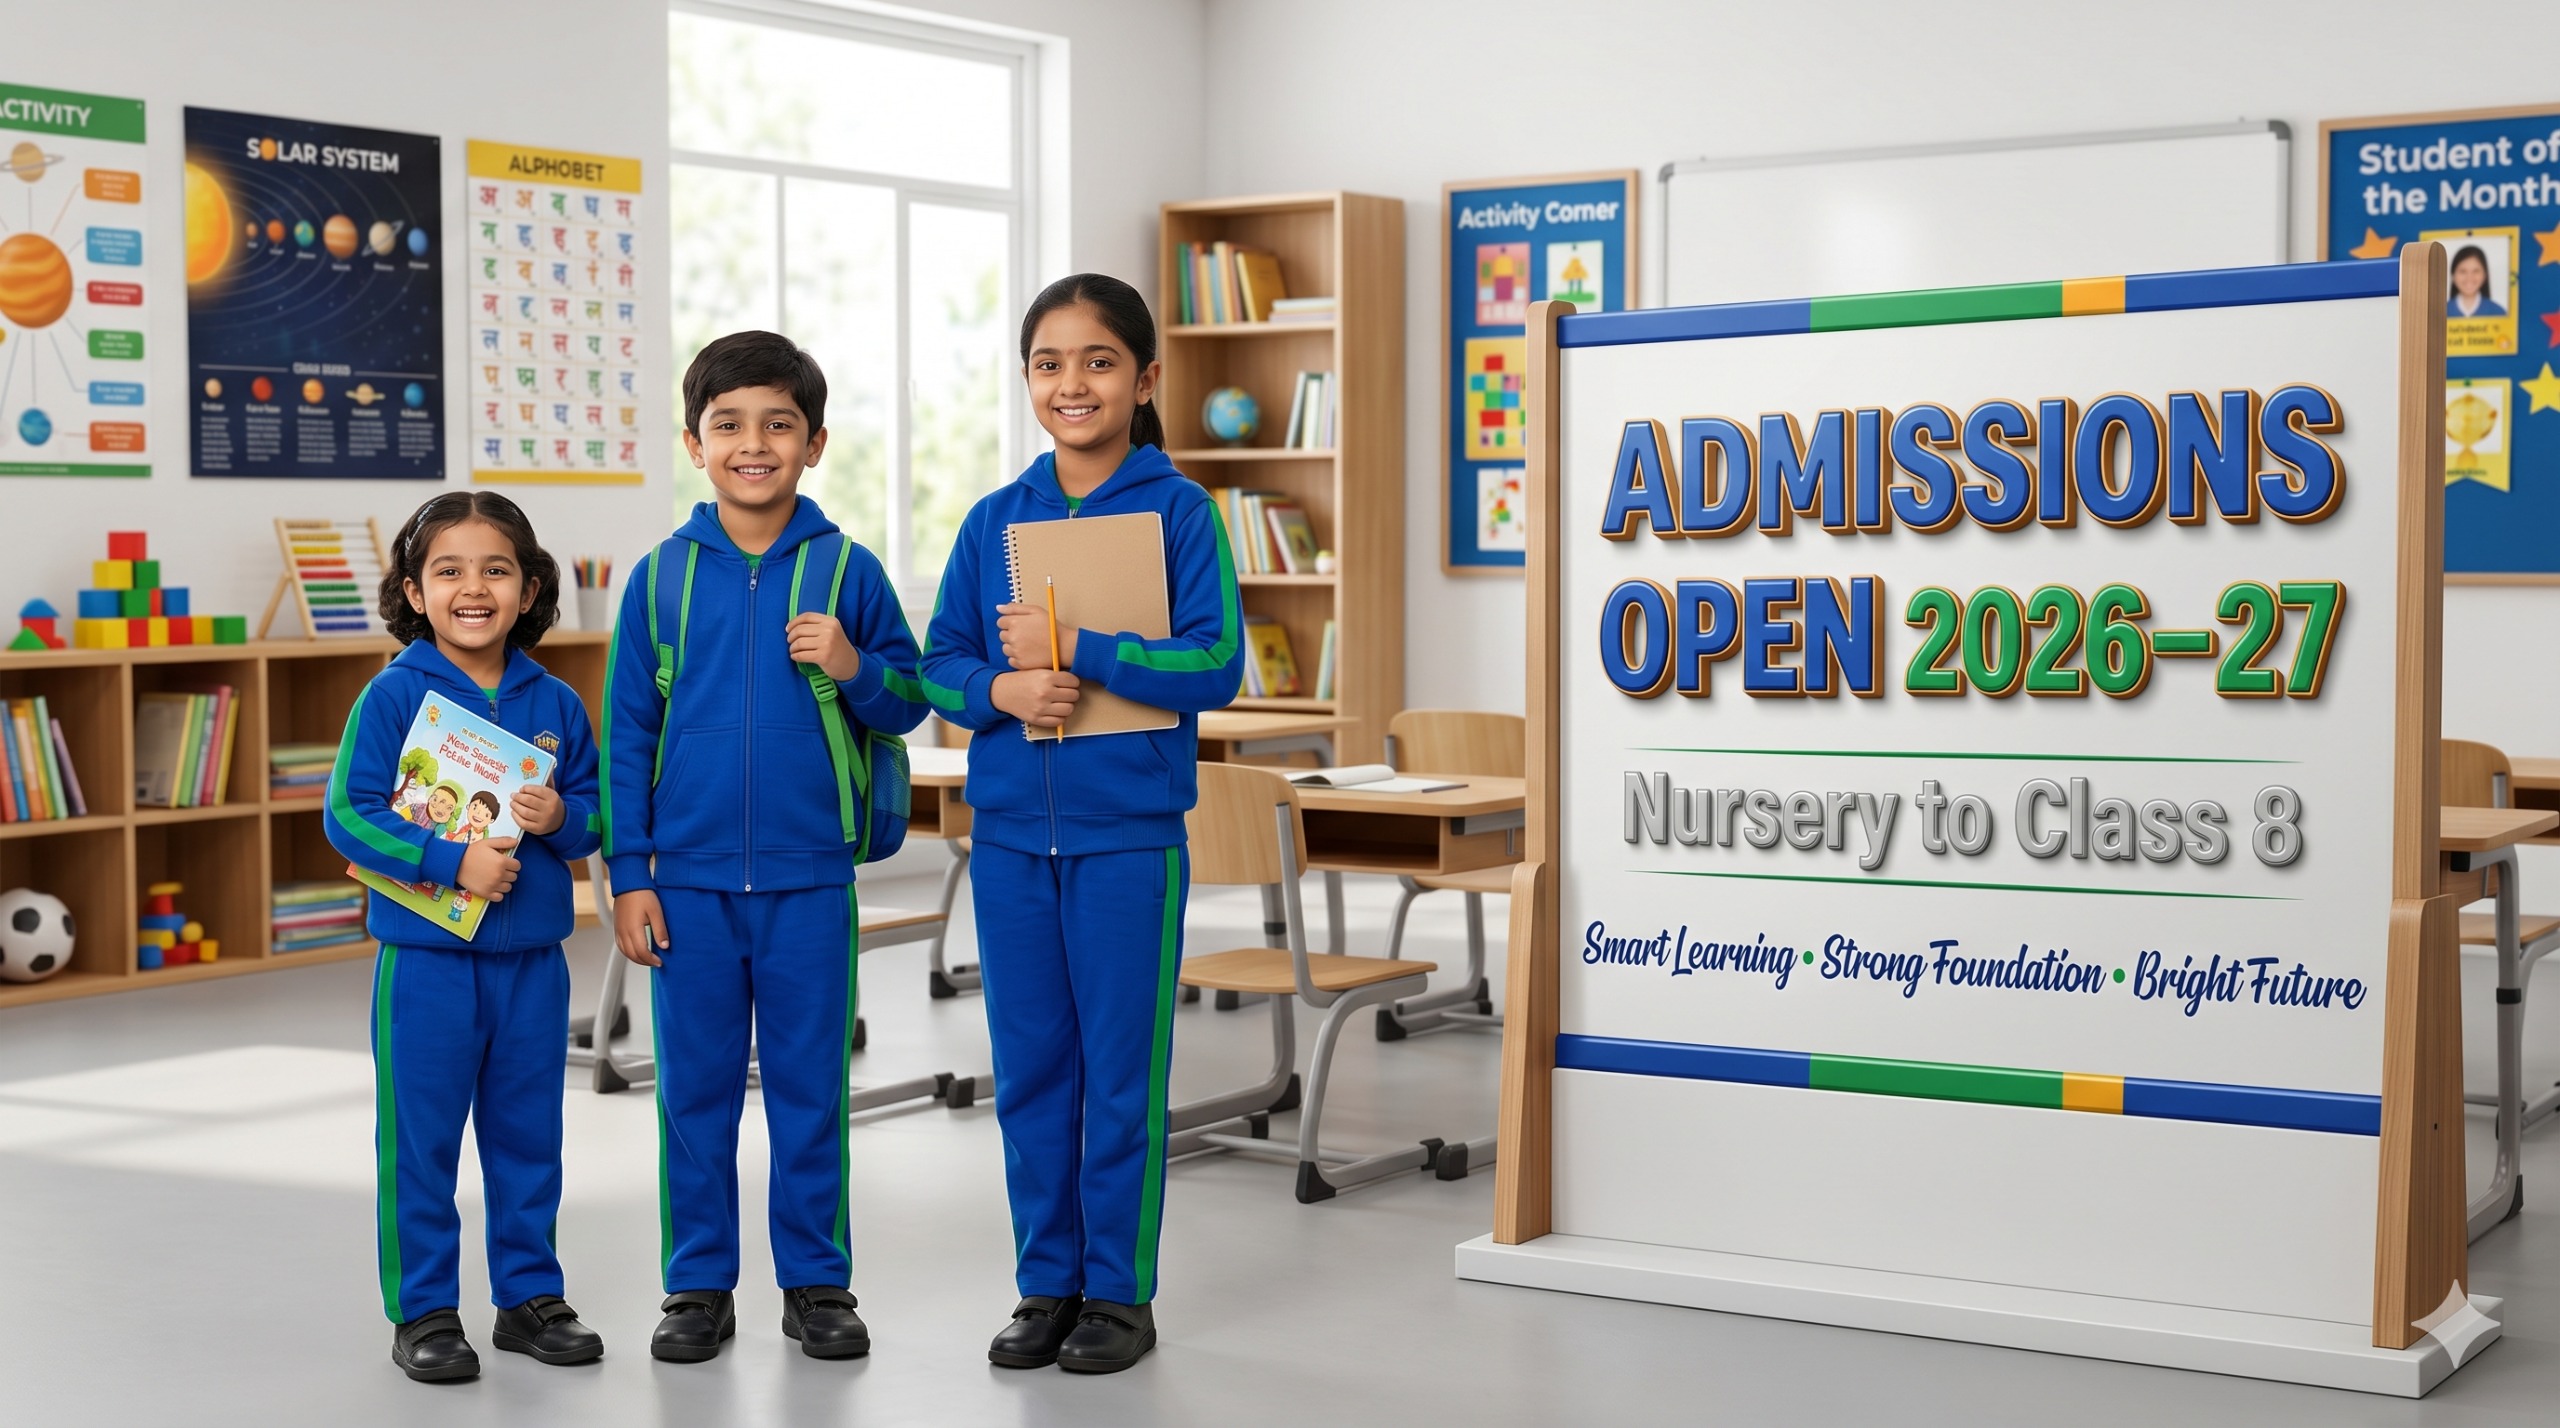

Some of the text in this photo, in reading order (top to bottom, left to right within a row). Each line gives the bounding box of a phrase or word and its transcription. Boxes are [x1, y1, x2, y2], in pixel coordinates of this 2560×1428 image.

[322, 146, 400, 174] SYSTEM
[509, 154, 605, 183] ALPHOBET
[2359, 129, 2560, 176] Student of
[1457, 200, 1620, 231] Activity Corner
[2362, 172, 2560, 216] the Month
[1599, 383, 2345, 541] ADMISSIONS
[1599, 573, 1886, 699] OPEN
[1623, 770, 2303, 870] Nursery to Class 8
[1583, 920, 2367, 1017] Smart Learning Strong Foundation Bright Future
